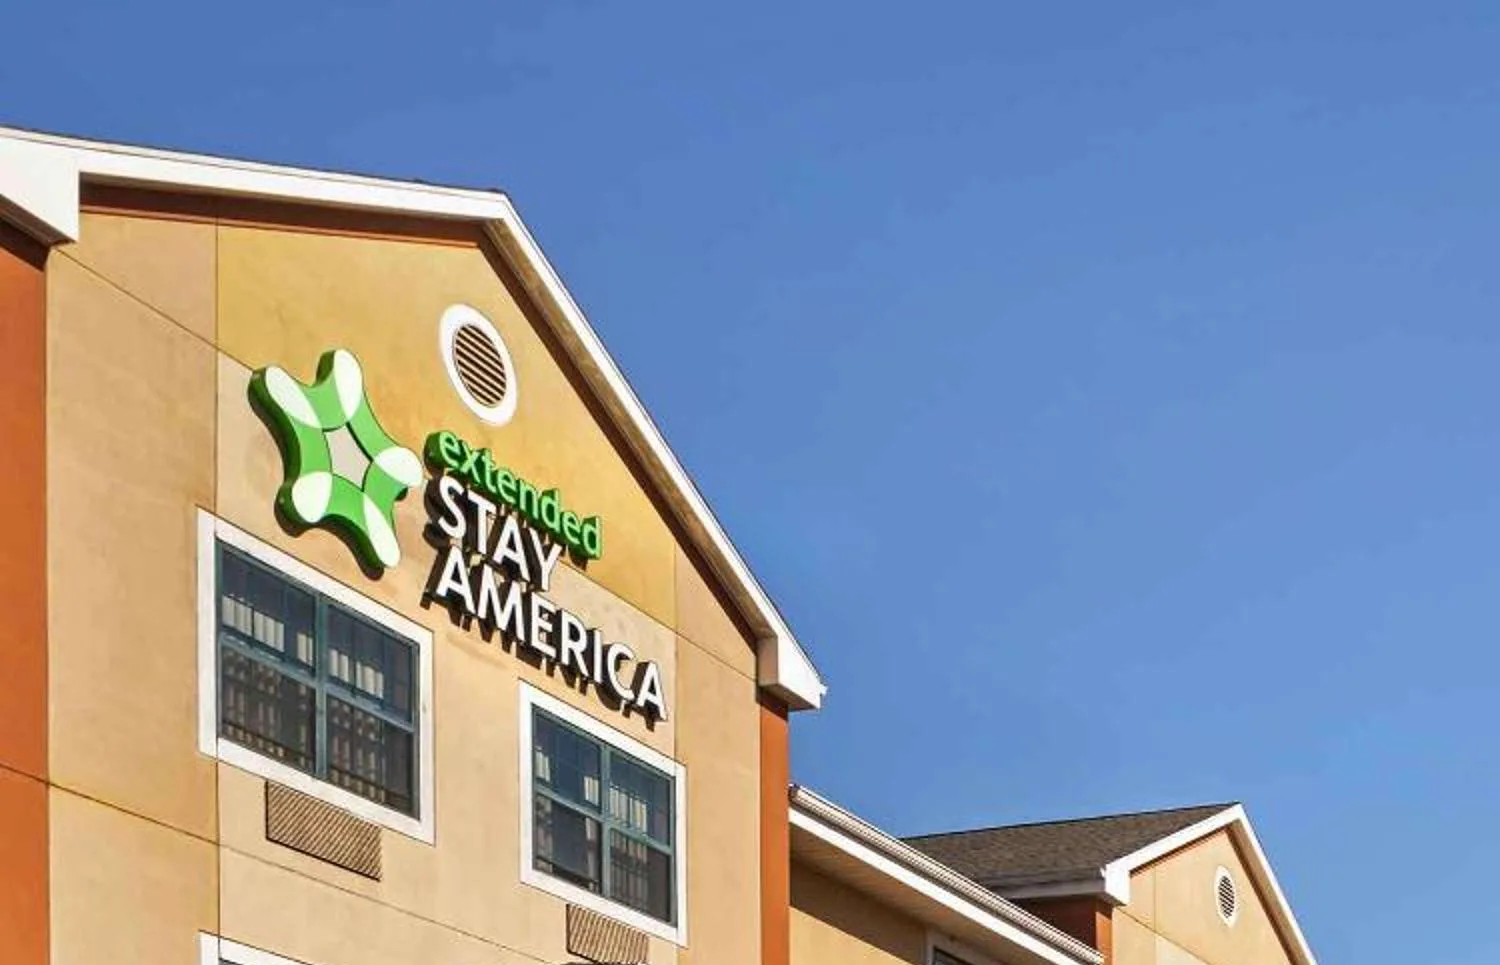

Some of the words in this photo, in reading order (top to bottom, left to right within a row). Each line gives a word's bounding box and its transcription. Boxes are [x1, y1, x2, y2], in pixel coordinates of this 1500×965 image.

[438, 430, 602, 560] extended
[438, 475, 561, 592] STAY
[438, 547, 667, 721] AMERICA
